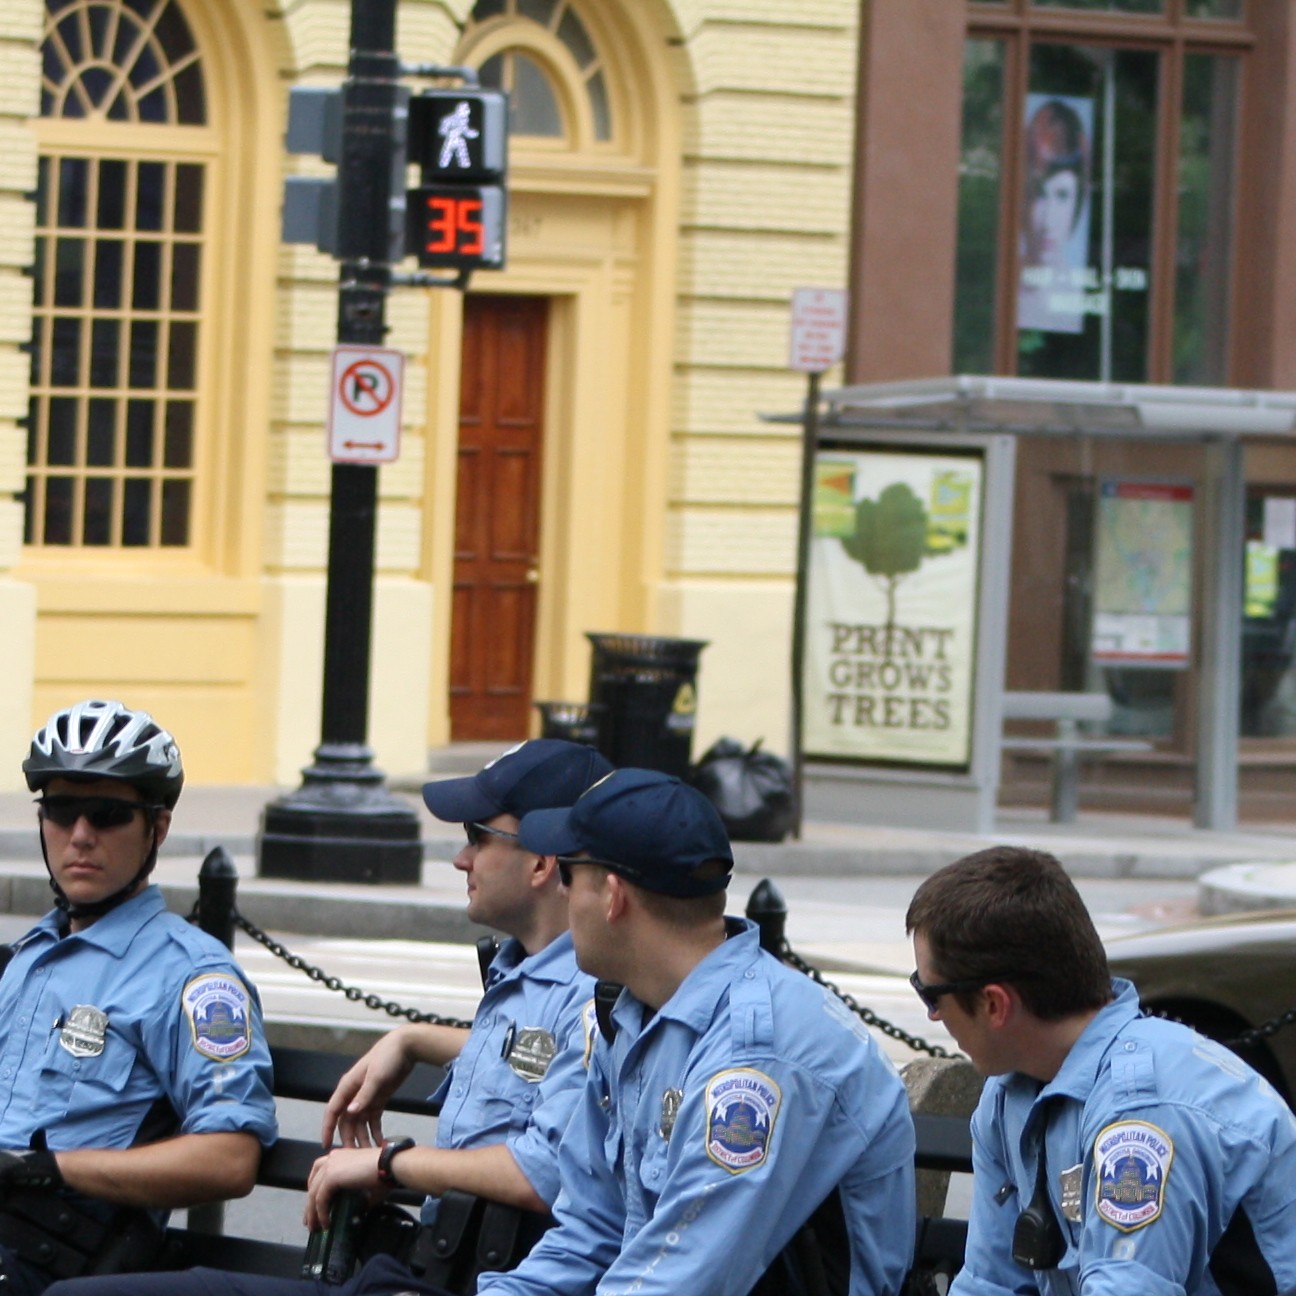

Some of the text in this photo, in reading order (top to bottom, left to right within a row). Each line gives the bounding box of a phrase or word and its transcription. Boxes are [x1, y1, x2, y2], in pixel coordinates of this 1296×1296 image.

[425, 196, 485, 255] 35
[826, 622, 955, 659] PRINT
[829, 659, 953, 693] GROWS
[827, 692, 951, 730] TREES
